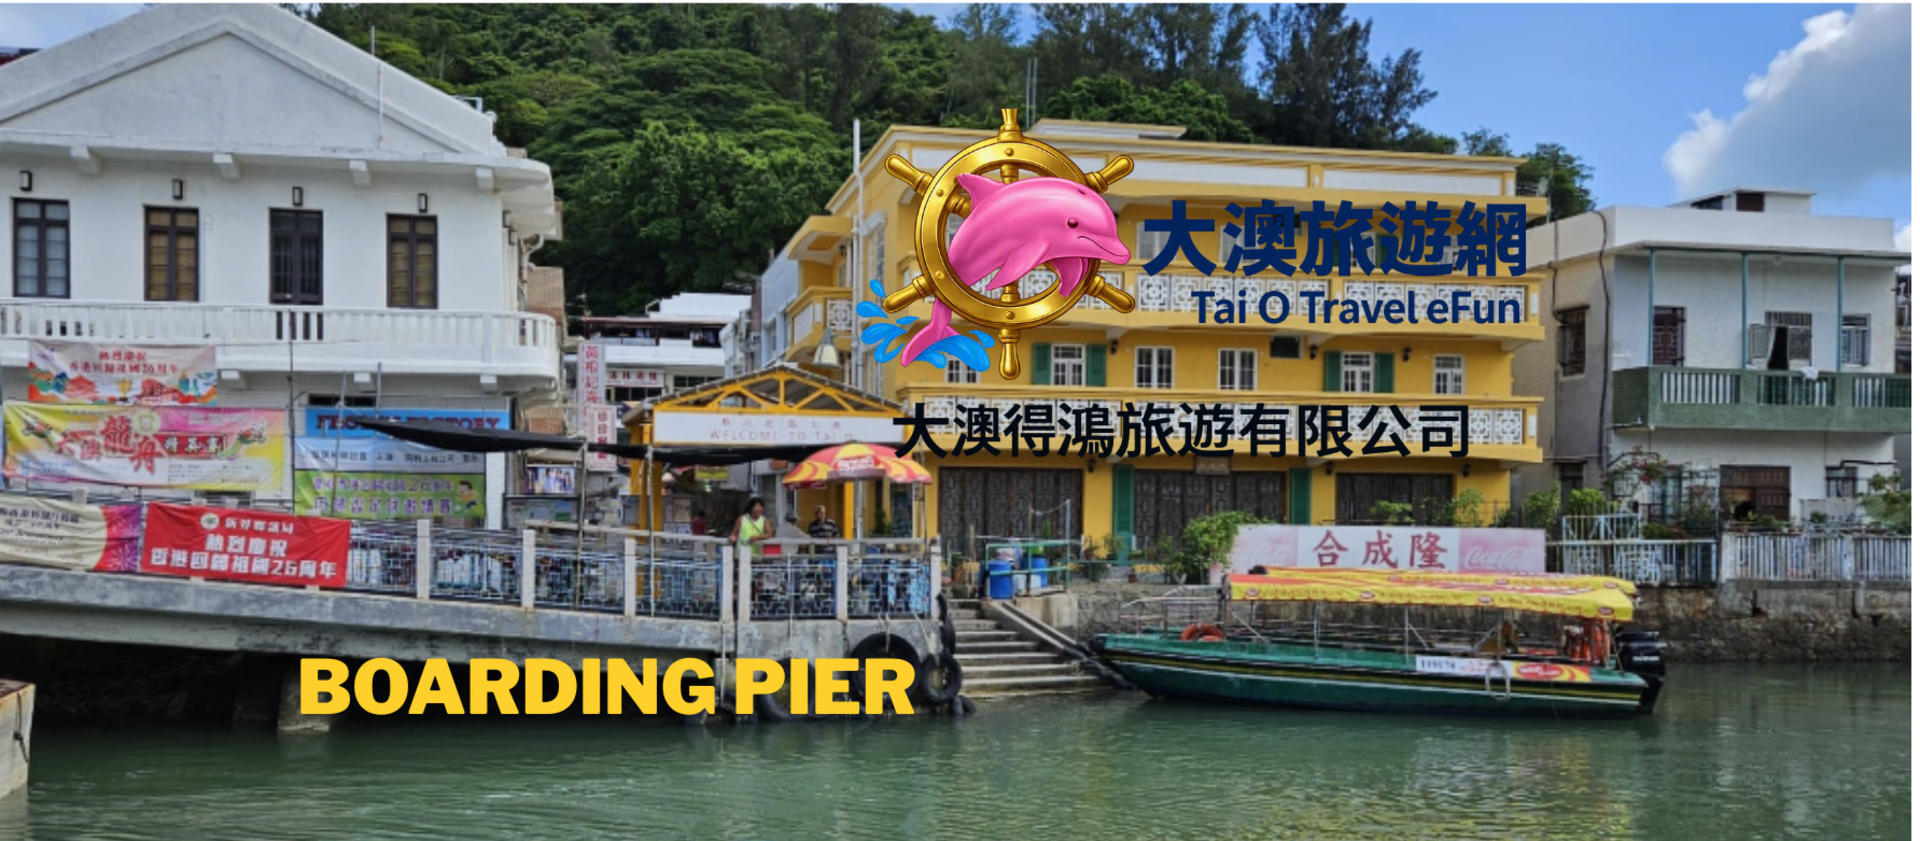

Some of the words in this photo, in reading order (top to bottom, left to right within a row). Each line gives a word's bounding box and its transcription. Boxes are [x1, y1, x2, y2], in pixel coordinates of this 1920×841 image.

[789, 431, 806, 441] TO
[205, 533, 287, 557] 熱烈慶祝
[1313, 529, 1448, 569] 合成隆
[150, 547, 337, 579] 香港回歸祖國26周年
